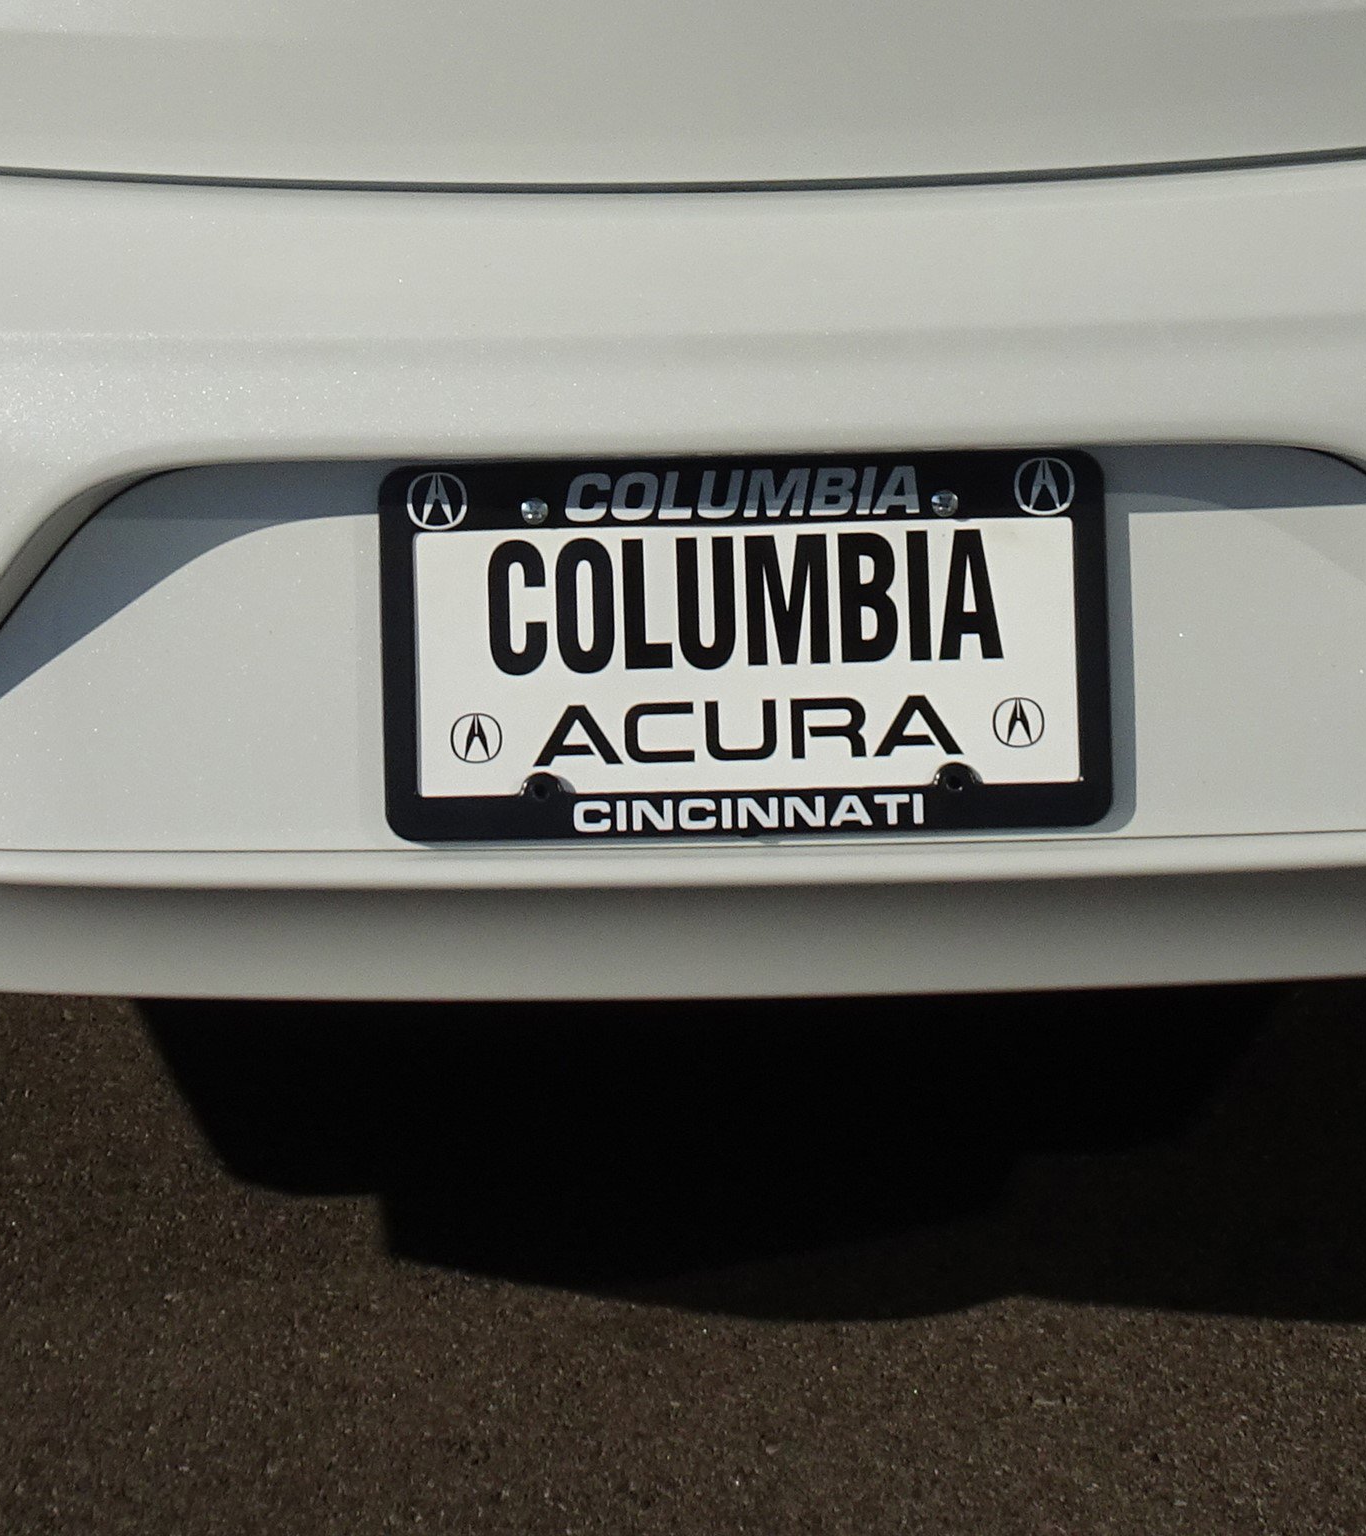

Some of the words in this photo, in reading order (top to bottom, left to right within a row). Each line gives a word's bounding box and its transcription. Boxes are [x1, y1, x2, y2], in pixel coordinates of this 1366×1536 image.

[563, 465, 922, 523] COLUMBIA
[487, 528, 1004, 676] COLUMBIA
[532, 694, 965, 767] ACURA
[572, 792, 926, 834] CINCINNATI
